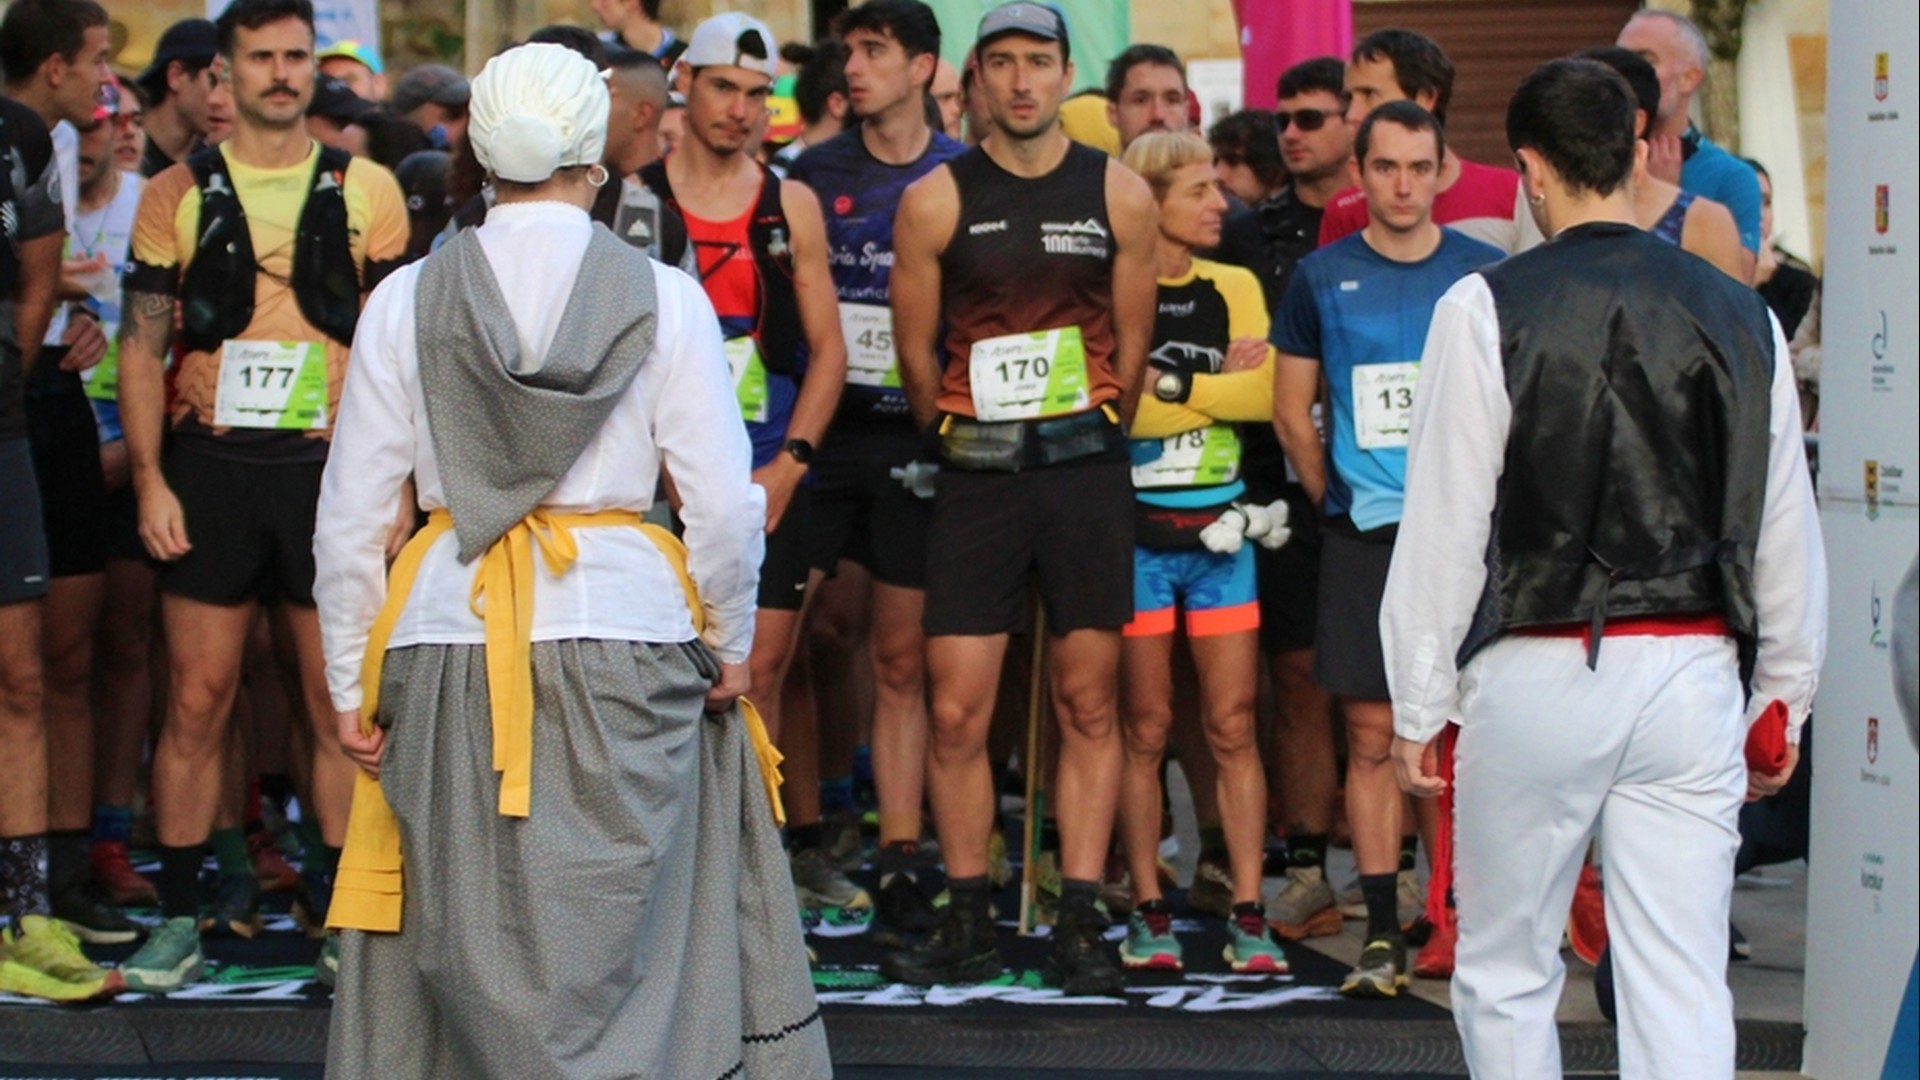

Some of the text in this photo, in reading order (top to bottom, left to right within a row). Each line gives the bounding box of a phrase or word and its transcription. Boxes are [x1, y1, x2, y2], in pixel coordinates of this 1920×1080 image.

[856, 329, 891, 351] 45
[239, 365, 294, 388] 177
[995, 357, 1049, 382] 170
[1378, 387, 1412, 410] 13
